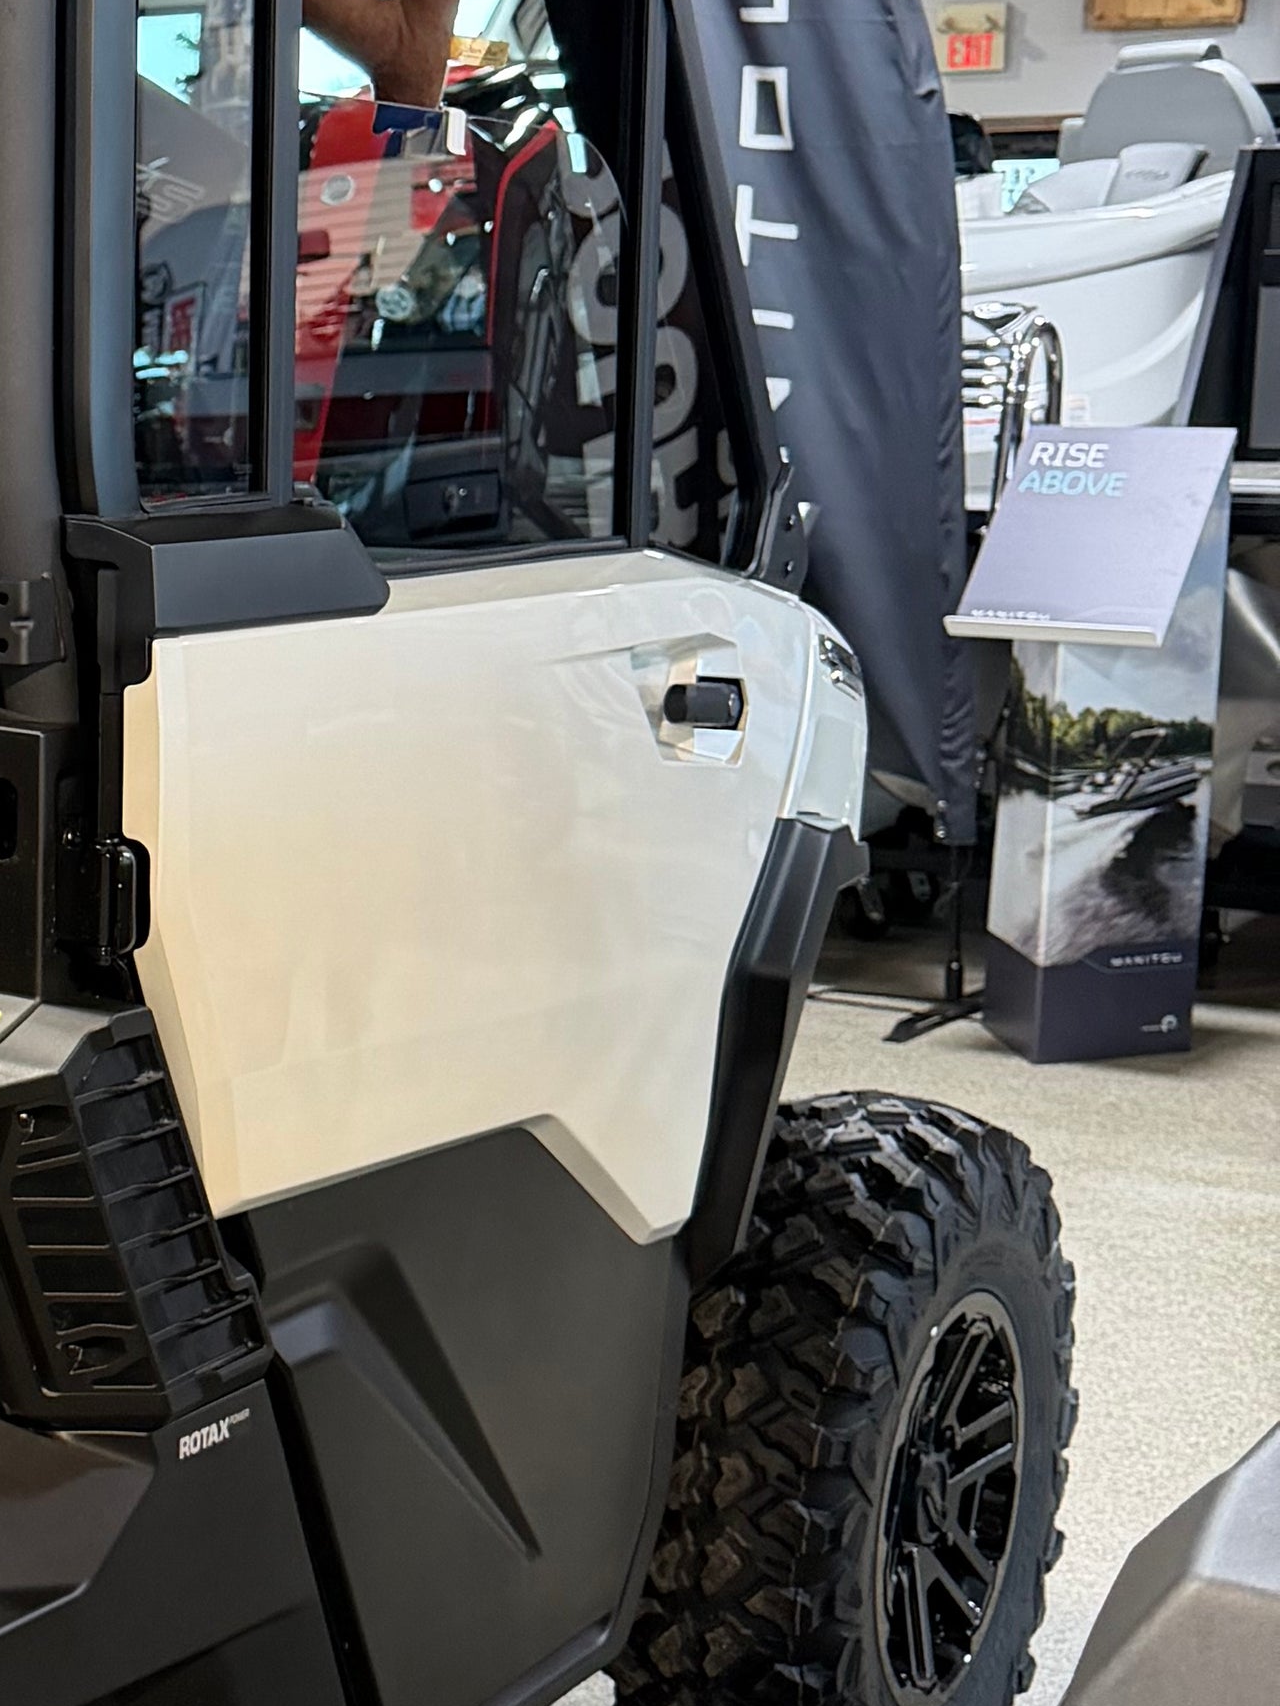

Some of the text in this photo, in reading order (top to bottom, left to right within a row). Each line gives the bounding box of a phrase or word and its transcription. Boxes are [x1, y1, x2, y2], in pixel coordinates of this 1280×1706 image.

[947, 34, 993, 68] EXIT
[1028, 441, 1109, 468] RISE
[1017, 469, 1129, 497] ABOVE
[178, 1416, 230, 1460] ROTAX
